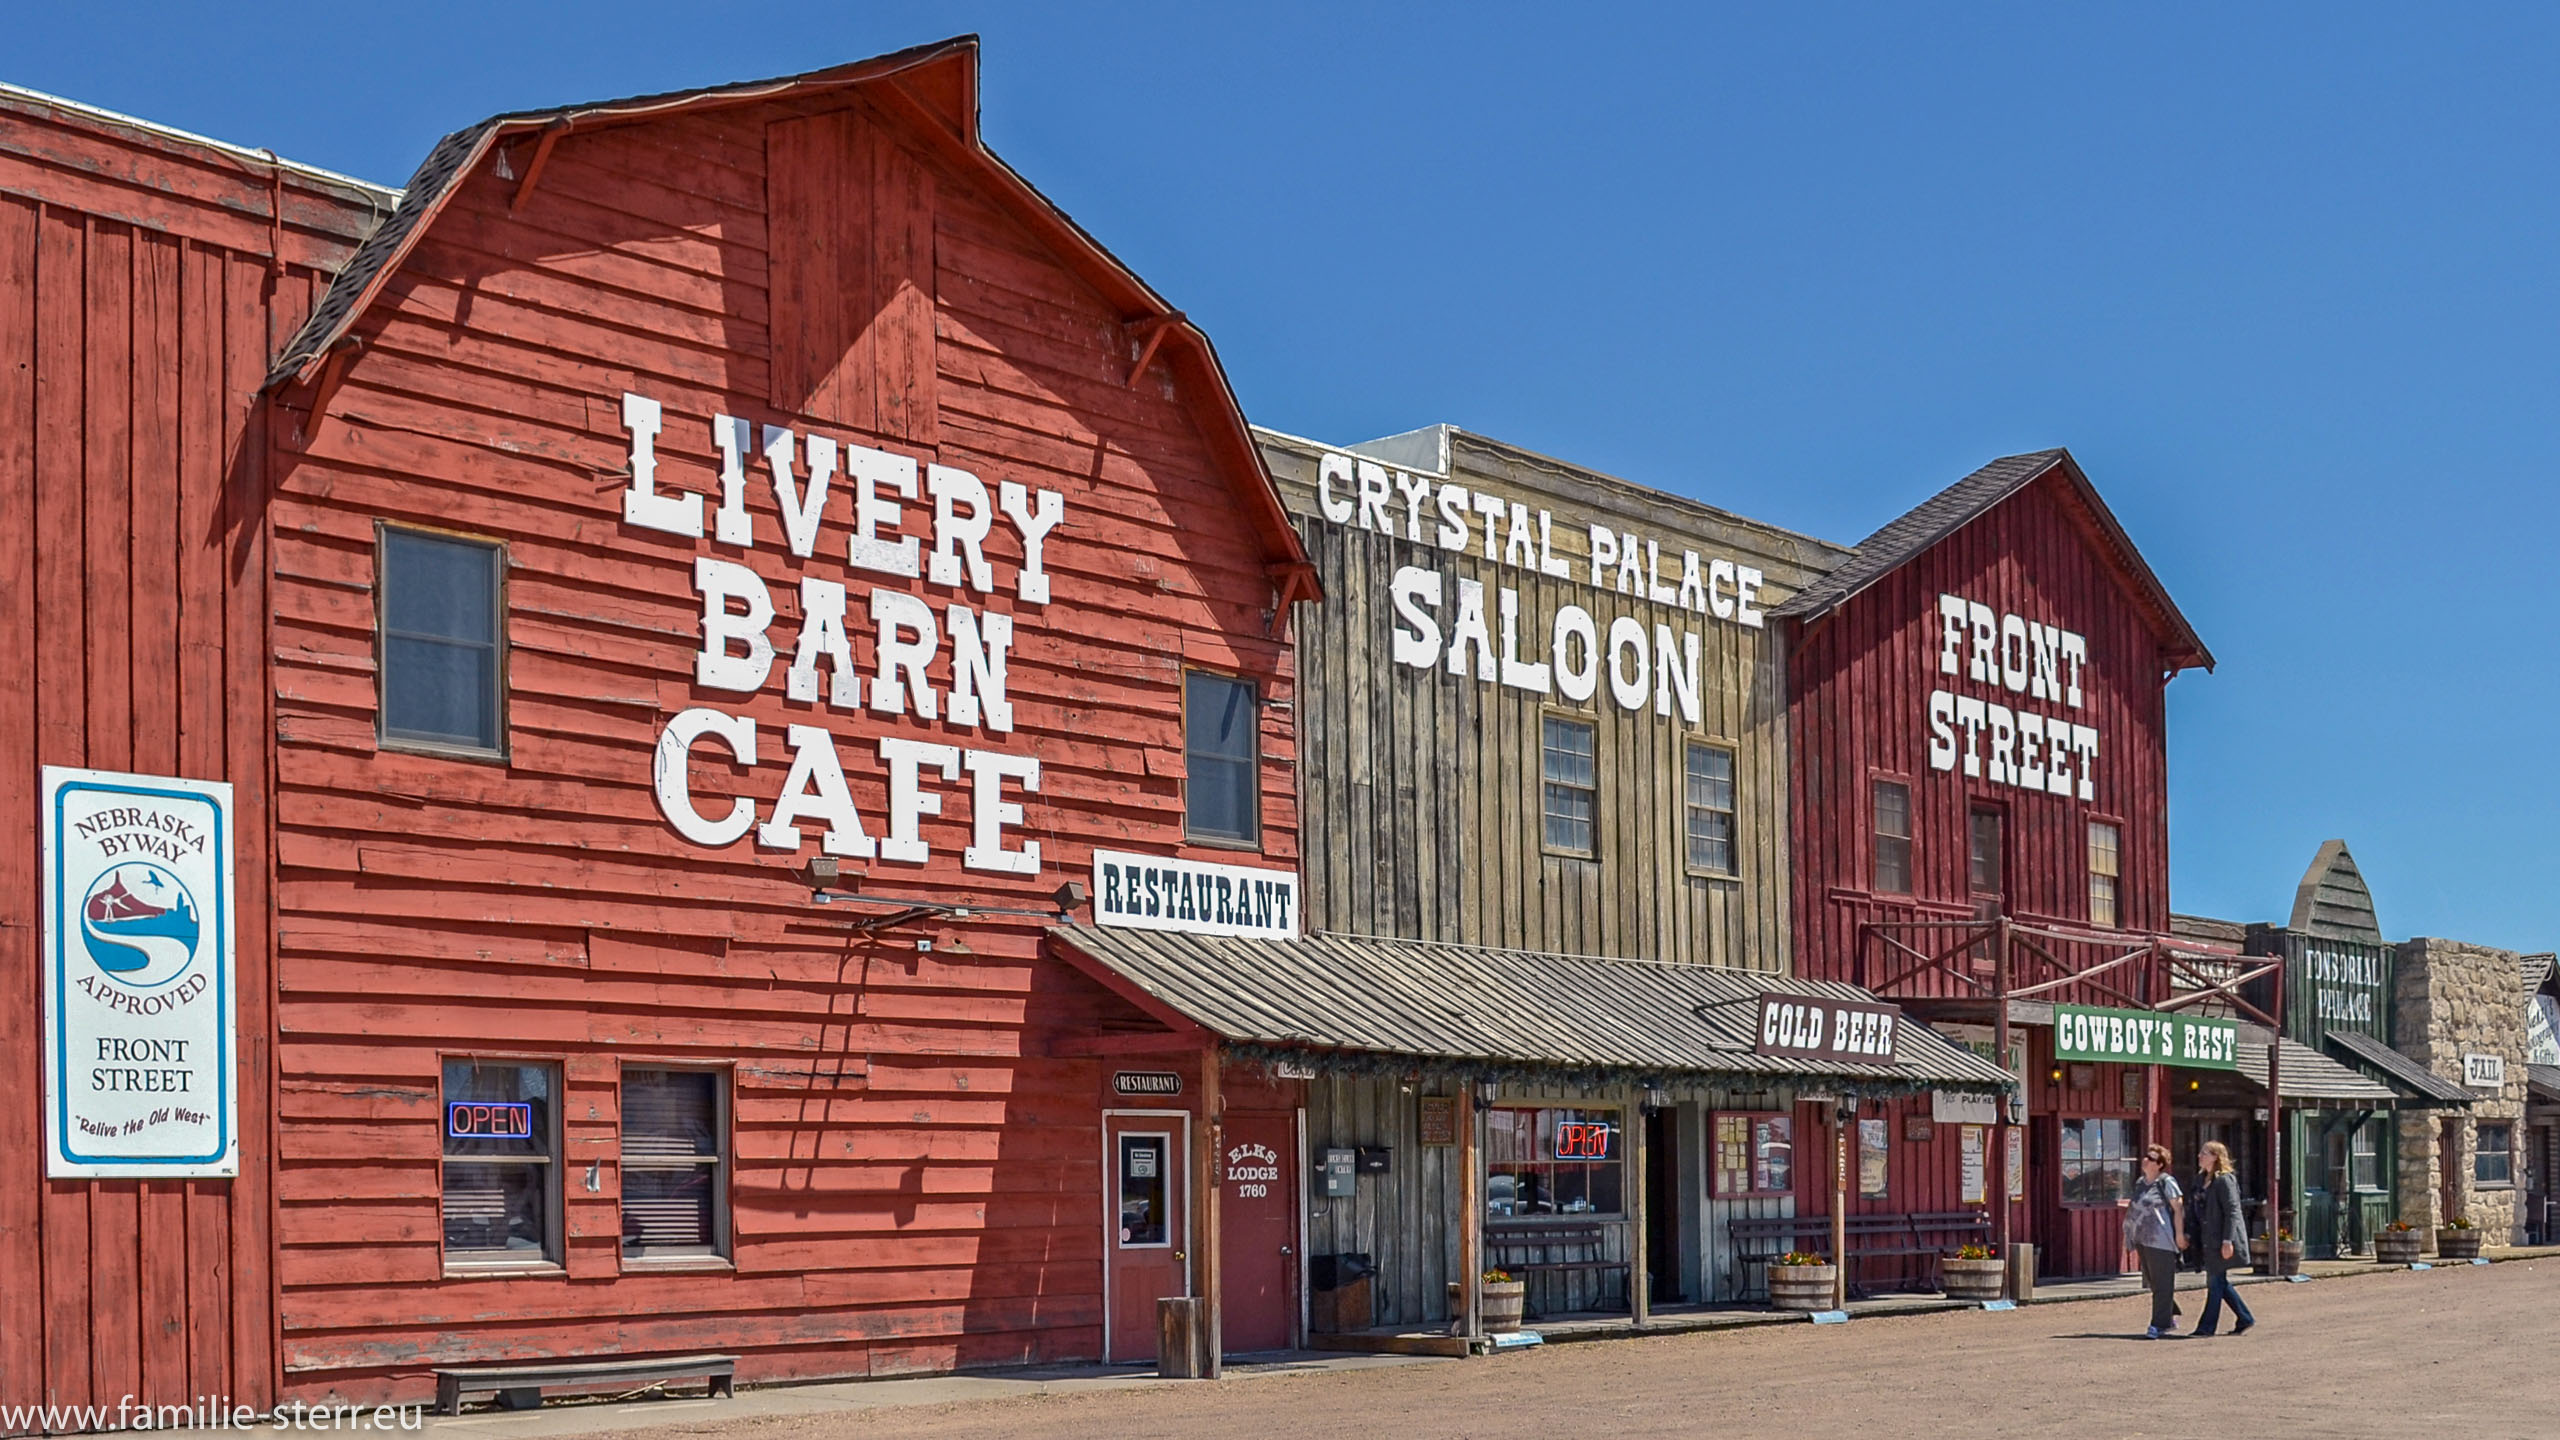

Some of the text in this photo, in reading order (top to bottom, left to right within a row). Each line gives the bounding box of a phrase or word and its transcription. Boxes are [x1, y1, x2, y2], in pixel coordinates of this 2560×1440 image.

[623, 392, 1064, 605] LIVERY
[1318, 452, 1764, 629] CRYSTAL PALACE
[695, 556, 1013, 733] BARN
[1389, 565, 1700, 723] SALOON
[1939, 592, 2086, 708] FRONT
[1929, 689, 2099, 801] STREET
[654, 707, 1041, 874] CAFE
[74, 807, 205, 854] NEBRASKA
[98, 833, 187, 864] BYWAY
[1103, 863, 1291, 930] RESTAURANT
[2305, 949, 2380, 987] TONSORIAL
[76, 973, 207, 1015] APPROVED
[2318, 988, 2371, 1022] PALACE
[1763, 1001, 1893, 1056] COLD BEER
[2059, 1013, 2236, 1062] COWBOY'S REST
[96, 1037, 189, 1063] FRONT
[2470, 1057, 2500, 1081] JAIL
[91, 1067, 193, 1092] STREET
[1120, 1075, 1174, 1091] RESTAURANT
[123, 1119, 144, 1136] the
[149, 1106, 170, 1126] Old
[453, 1105, 527, 1134] OPEN
[1228, 1143, 1278, 1165] ELKS
[1559, 1125, 1607, 1156] OPEN
[1228, 1167, 1278, 1181] LODGE
[1239, 1184, 1267, 1198] 1760
